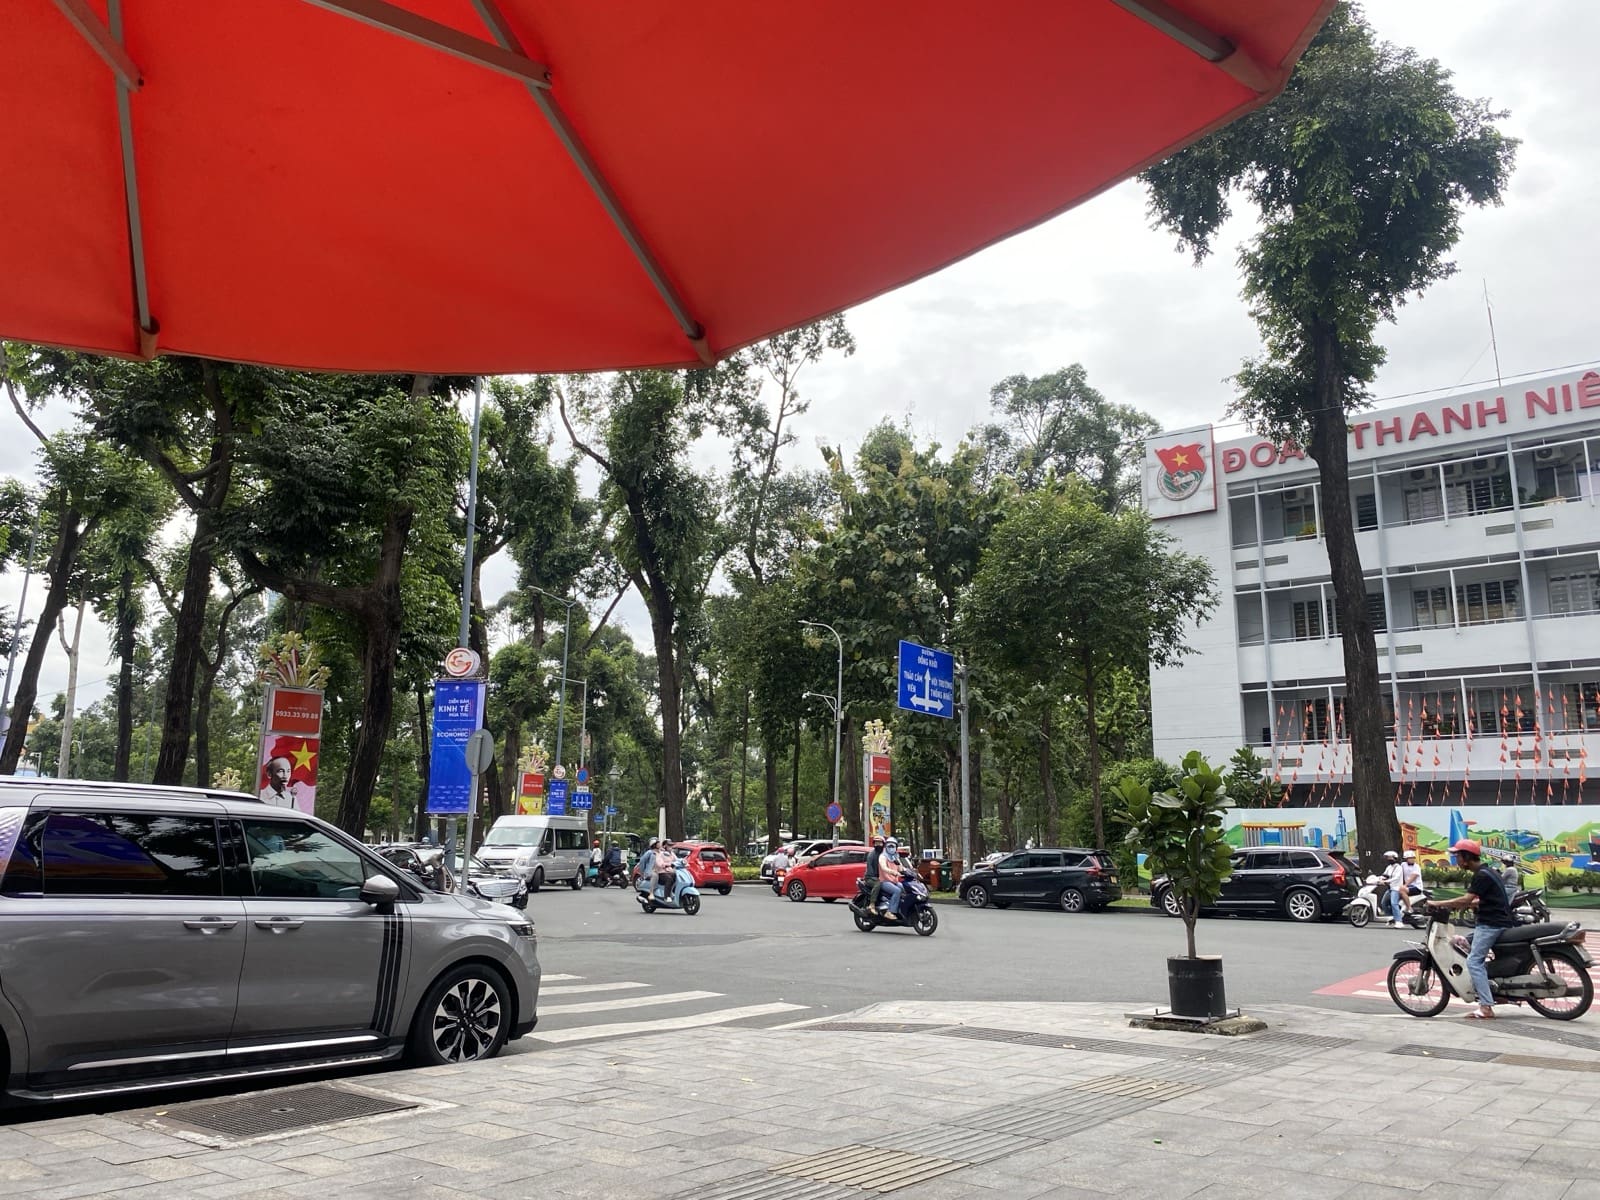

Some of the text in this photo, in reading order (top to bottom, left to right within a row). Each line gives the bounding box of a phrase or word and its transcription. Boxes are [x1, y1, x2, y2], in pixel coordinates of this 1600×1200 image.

[1222, 371, 1600, 474] ĐOA THANH NIÊ
[438, 703, 470, 713] KINH TẾ
